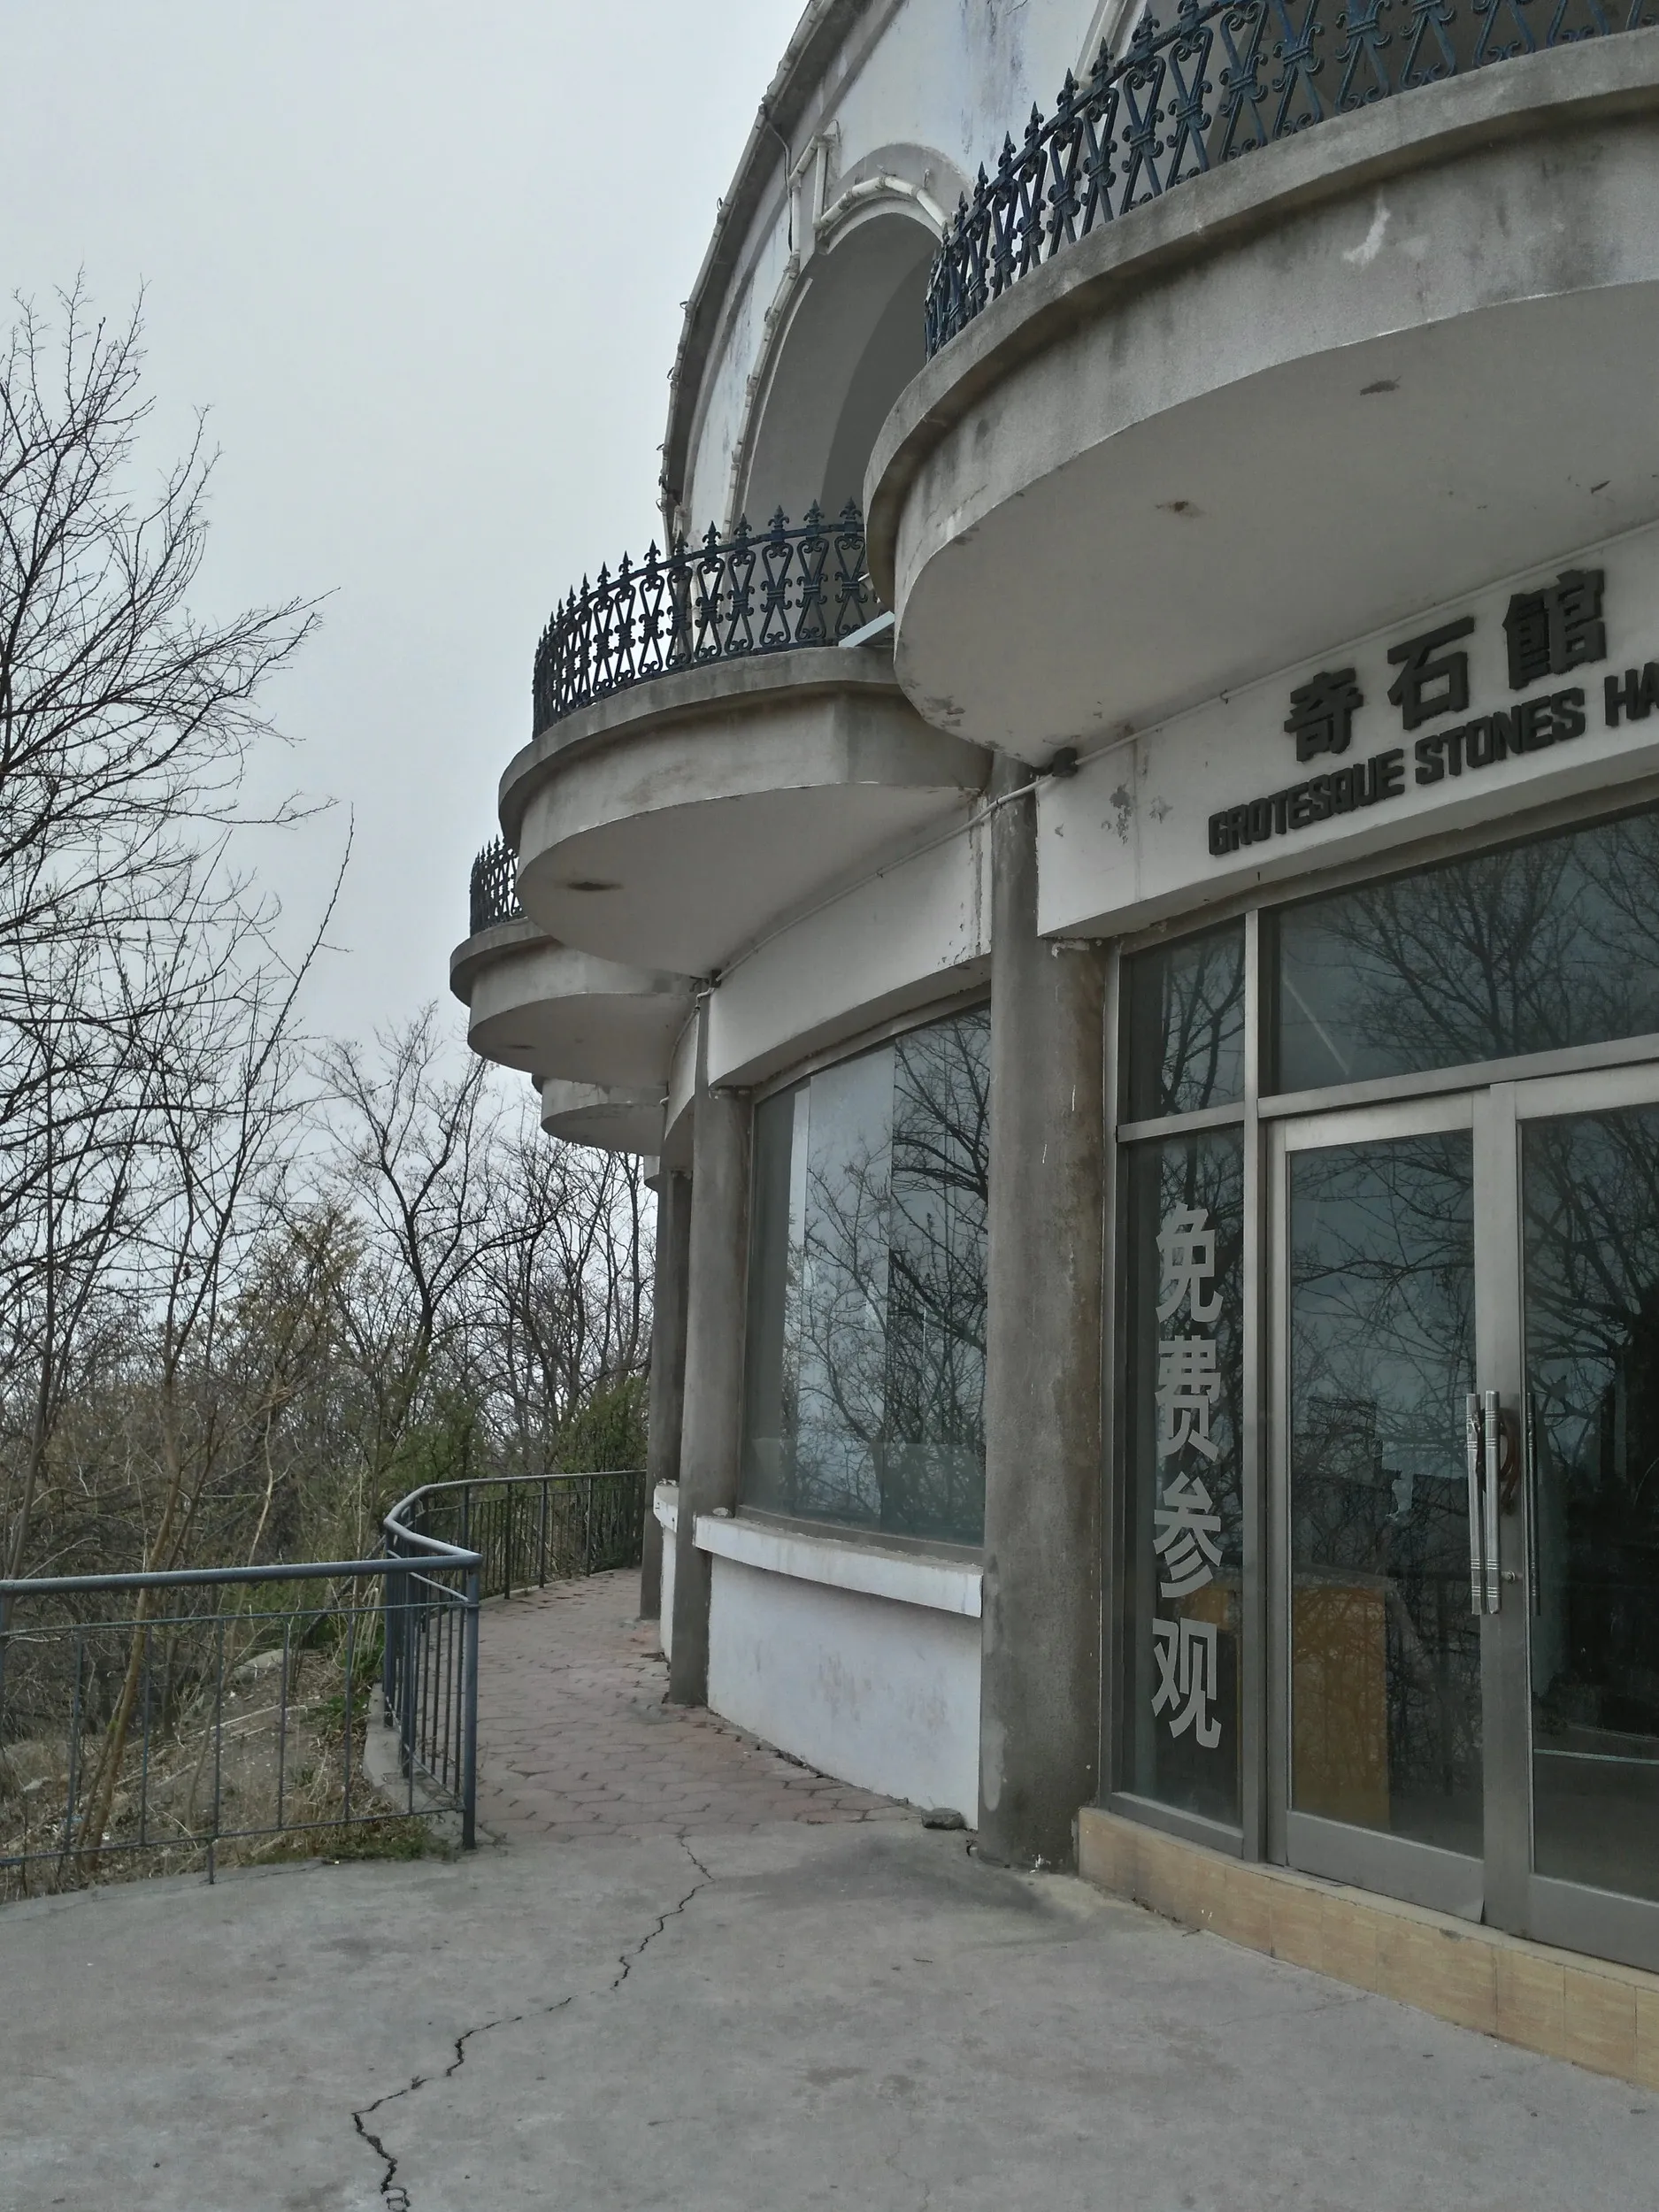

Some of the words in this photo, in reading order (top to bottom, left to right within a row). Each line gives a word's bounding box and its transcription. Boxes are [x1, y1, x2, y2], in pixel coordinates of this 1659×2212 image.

[1283, 568, 1606, 762] 奇石館
[1209, 748, 1405, 856] GROTESQUE
[1415, 687, 1586, 785] STONES
[1151, 1202, 1223, 1749] 免费参观
